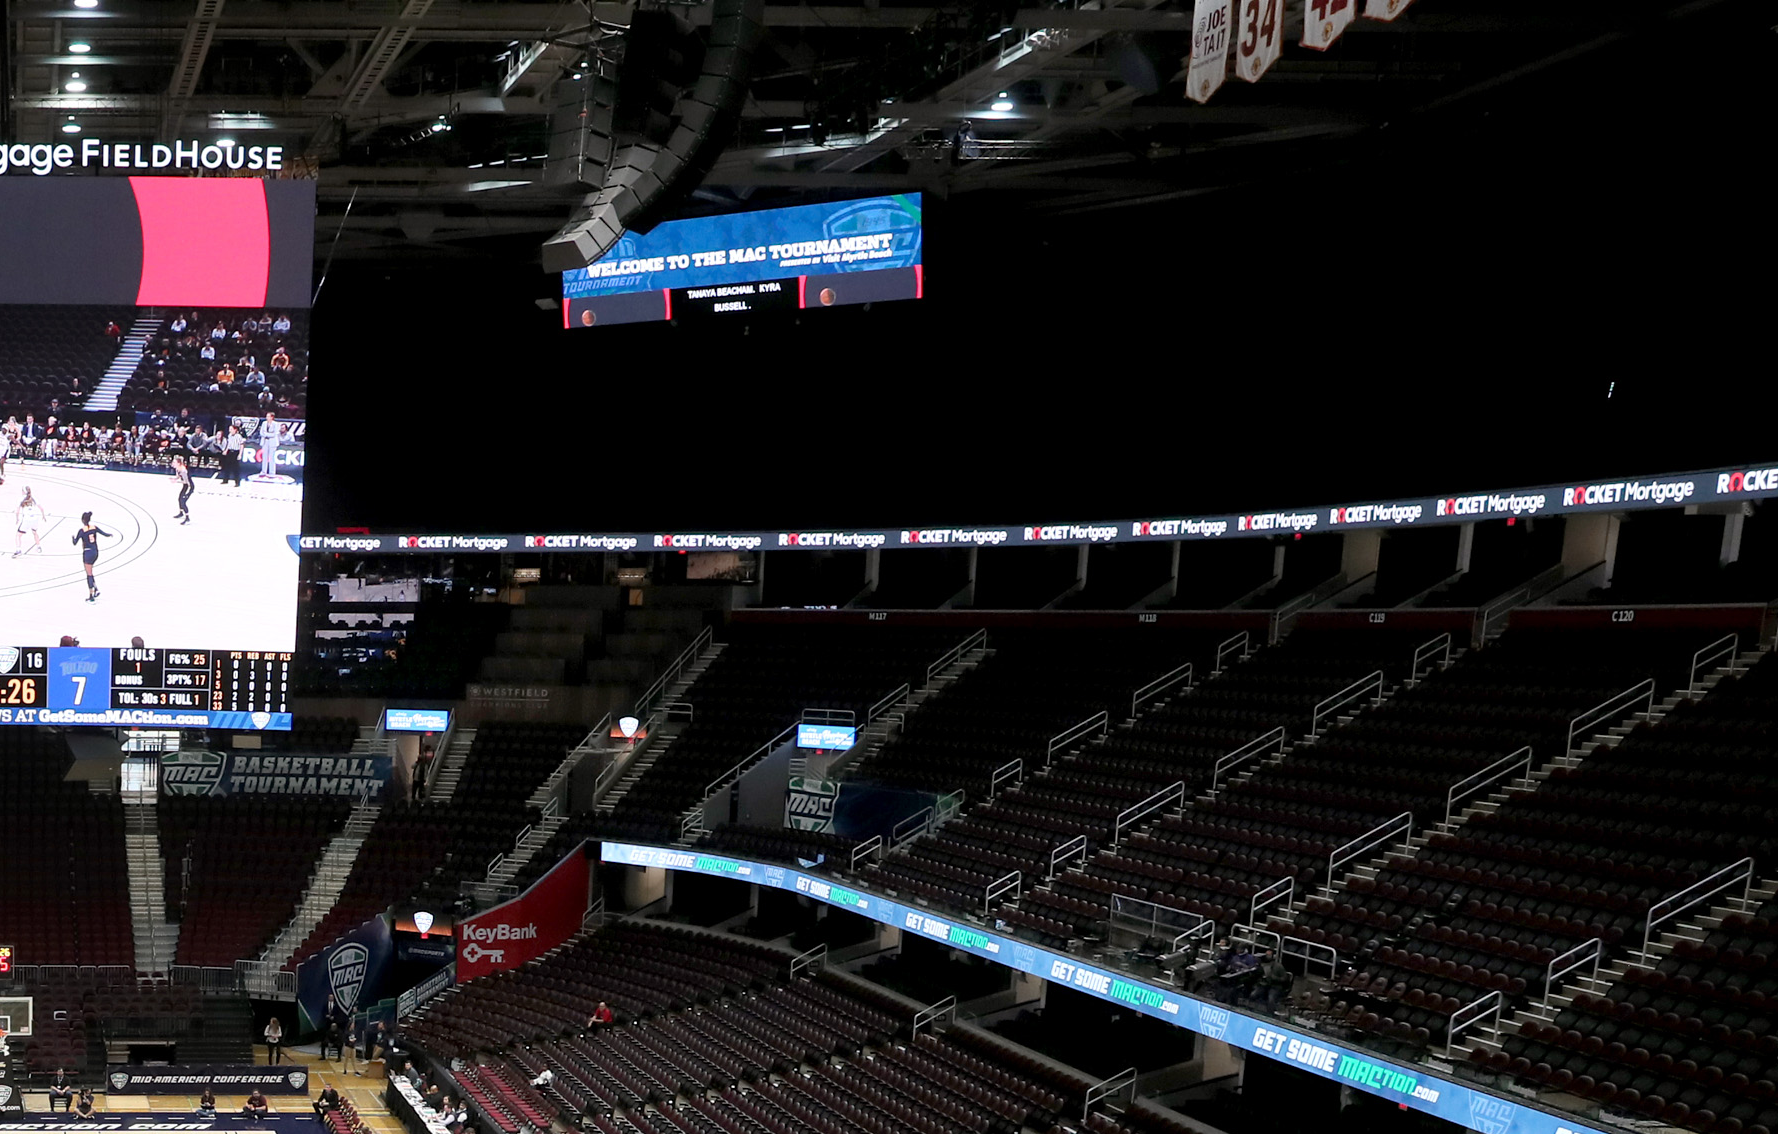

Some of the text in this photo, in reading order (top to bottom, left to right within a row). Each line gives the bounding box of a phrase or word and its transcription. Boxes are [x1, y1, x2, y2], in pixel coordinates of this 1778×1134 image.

[1206, 6, 1226, 33] JOE
[1240, 0, 1277, 57] 34
[1204, 29, 1226, 56] TAIT
[588, 233, 893, 278] WELCOME TO THE MAC TOURNAMENT
[822, 253, 841, 264] Visit
[842, 250, 868, 264] Myrtle
[687, 288, 716, 299] TANAYA
[759, 282, 781, 294] KYRA
[1564, 480, 1694, 507] ROCKET Mortgage
[1330, 502, 1421, 524] ROCKET Mortgage
[1437, 492, 1545, 516] ROCKET Mortgage
[324, 536, 380, 551] Mortgage
[399, 536, 508, 550] ROCKET Mortgage
[654, 534, 761, 549] ROCKET Mortgage
[778, 532, 885, 548] ROCKET Mortgage
[26, 653, 43, 669] 16
[120, 648, 156, 661] FOULS
[169, 654, 206, 666] FG% 25
[115, 675, 143, 686] BONUS
[166, 675, 206, 686] 3PT% 17
[72, 676, 87, 706] 7
[118, 693, 139, 704] TOL:
[142, 693, 159, 704] 30s
[169, 694, 192, 705] FULL
[15, 709, 37, 723] AT
[39, 710, 208, 726] GetSomeMACtion.com
[164, 766, 222, 782] MAC
[232, 756, 375, 776] BASKETBALL
[230, 775, 385, 797] TOURNAMENT
[788, 793, 834, 817] MAC
[630, 850, 657, 862] GET
[658, 852, 695, 868] SOME
[462, 922, 537, 943] KeyBank
[332, 965, 364, 986] MAC
[1051, 960, 1074, 981] GET
[1075, 968, 1111, 995] SOME
[1253, 1027, 1287, 1054] GET
[1286, 1037, 1338, 1073] SOME
[130, 1074, 284, 1085] MID-AMERICAN CONFERENCE
